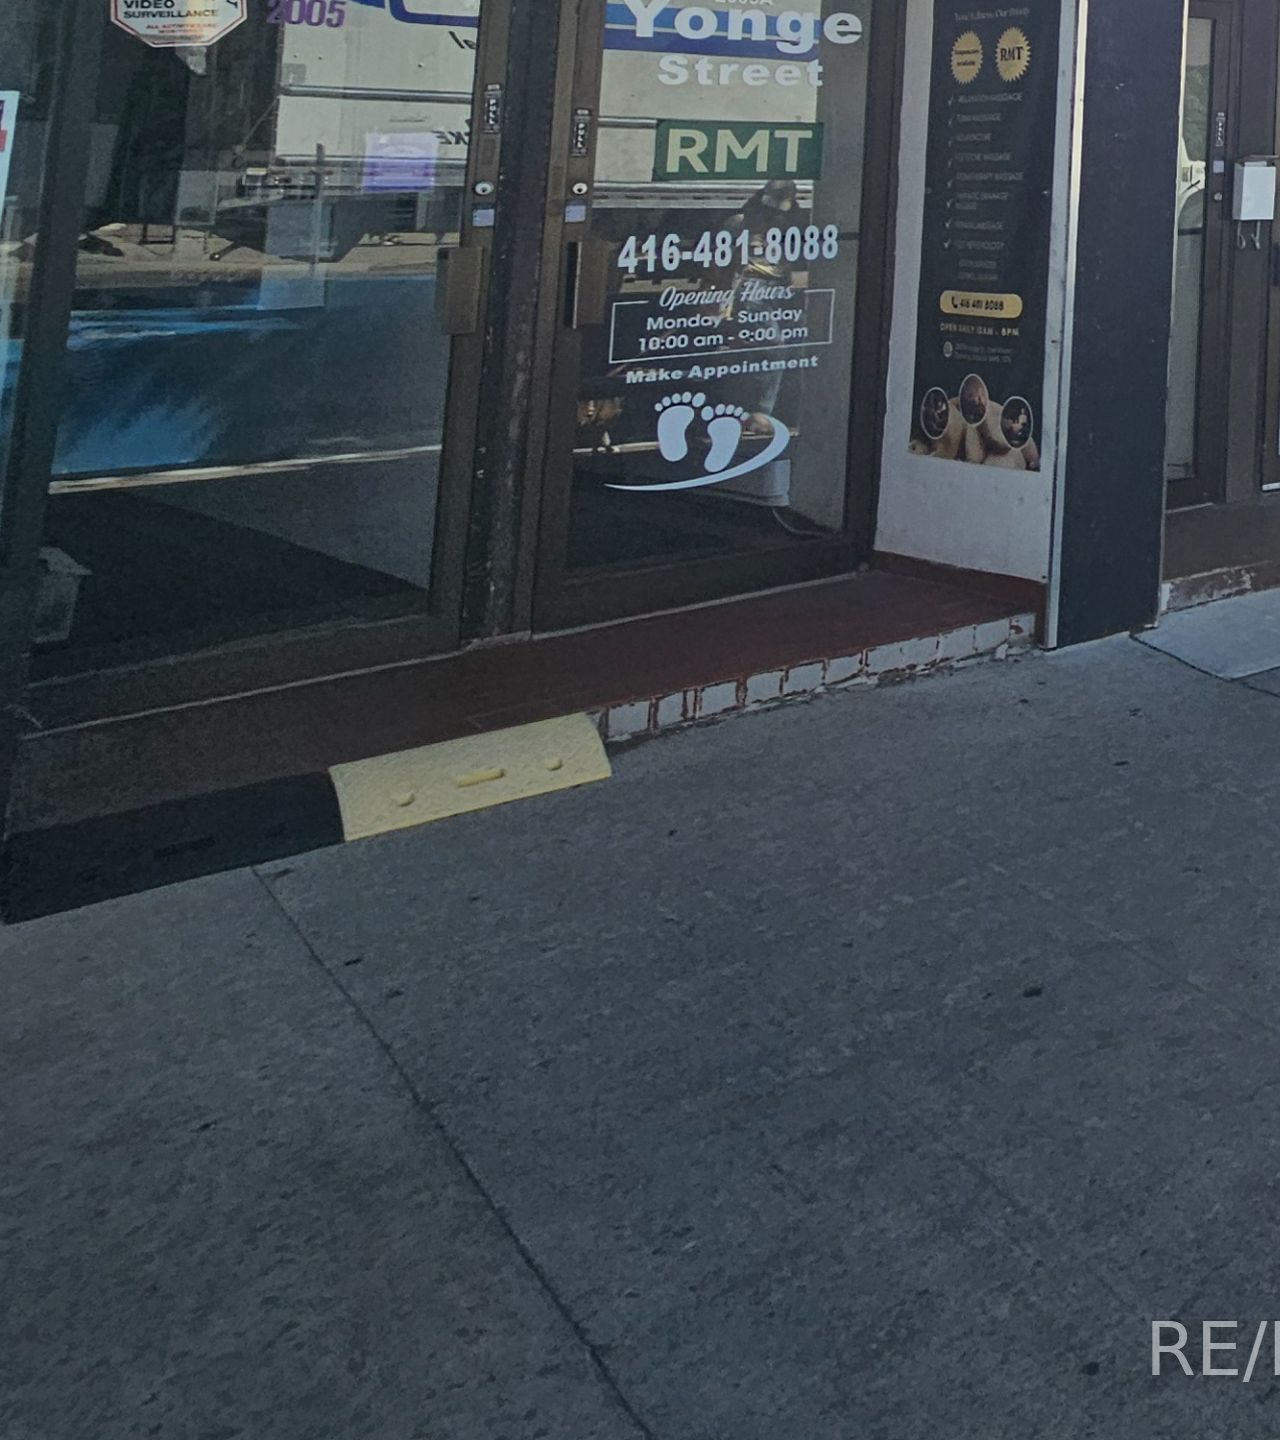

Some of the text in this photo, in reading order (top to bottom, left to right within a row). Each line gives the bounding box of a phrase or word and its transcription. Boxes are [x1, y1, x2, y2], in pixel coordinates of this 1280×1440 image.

[123, 0, 175, 9] VIDEO
[123, 10, 218, 19] SURVEILLANCE
[1000, 46, 1023, 61] RMT
[657, 55, 823, 86] Street
[666, 128, 813, 174] RMT
[617, 224, 838, 274] 416-481-8088
[659, 280, 796, 311] Opening Hours
[645, 314, 722, 331] Monday
[738, 308, 802, 324] Sunday
[639, 335, 689, 352] 10:00
[694, 334, 723, 348] am
[781, 327, 808, 343] pm
[625, 356, 820, 385] Make Appointment
